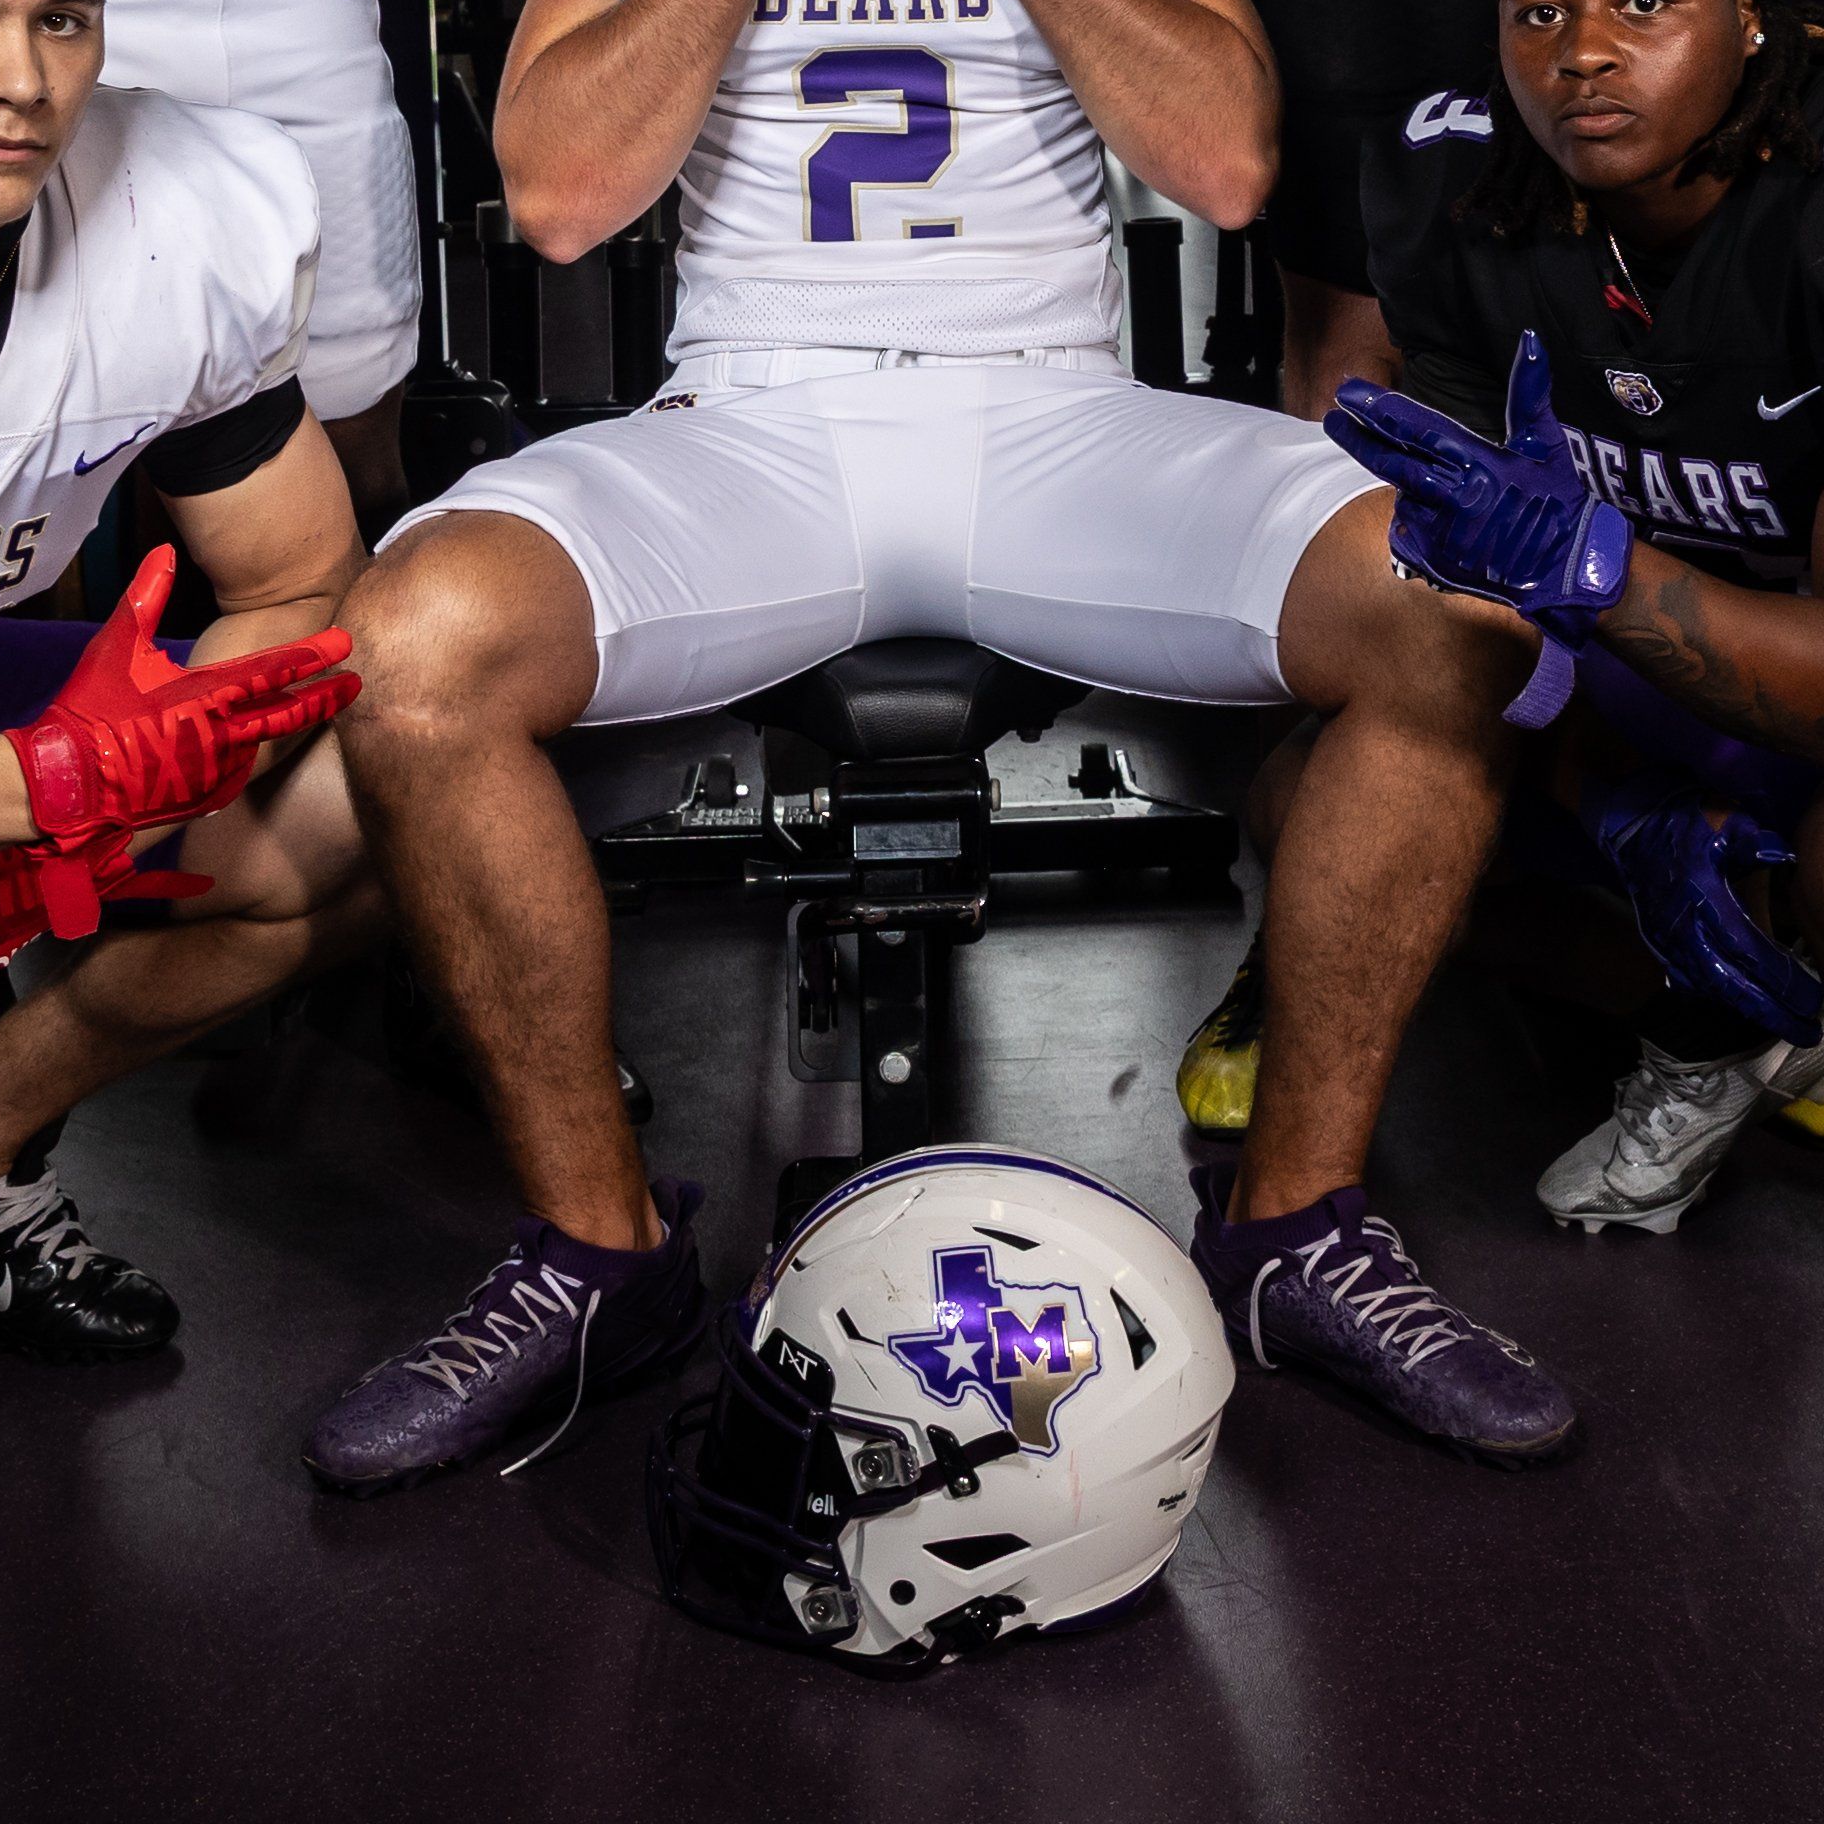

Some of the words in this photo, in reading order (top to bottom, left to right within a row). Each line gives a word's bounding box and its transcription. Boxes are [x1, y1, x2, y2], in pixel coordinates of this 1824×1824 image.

[790, 43, 964, 243] 2
[1561, 422, 1790, 540] BEARS
[987, 1303, 1074, 1384] M
